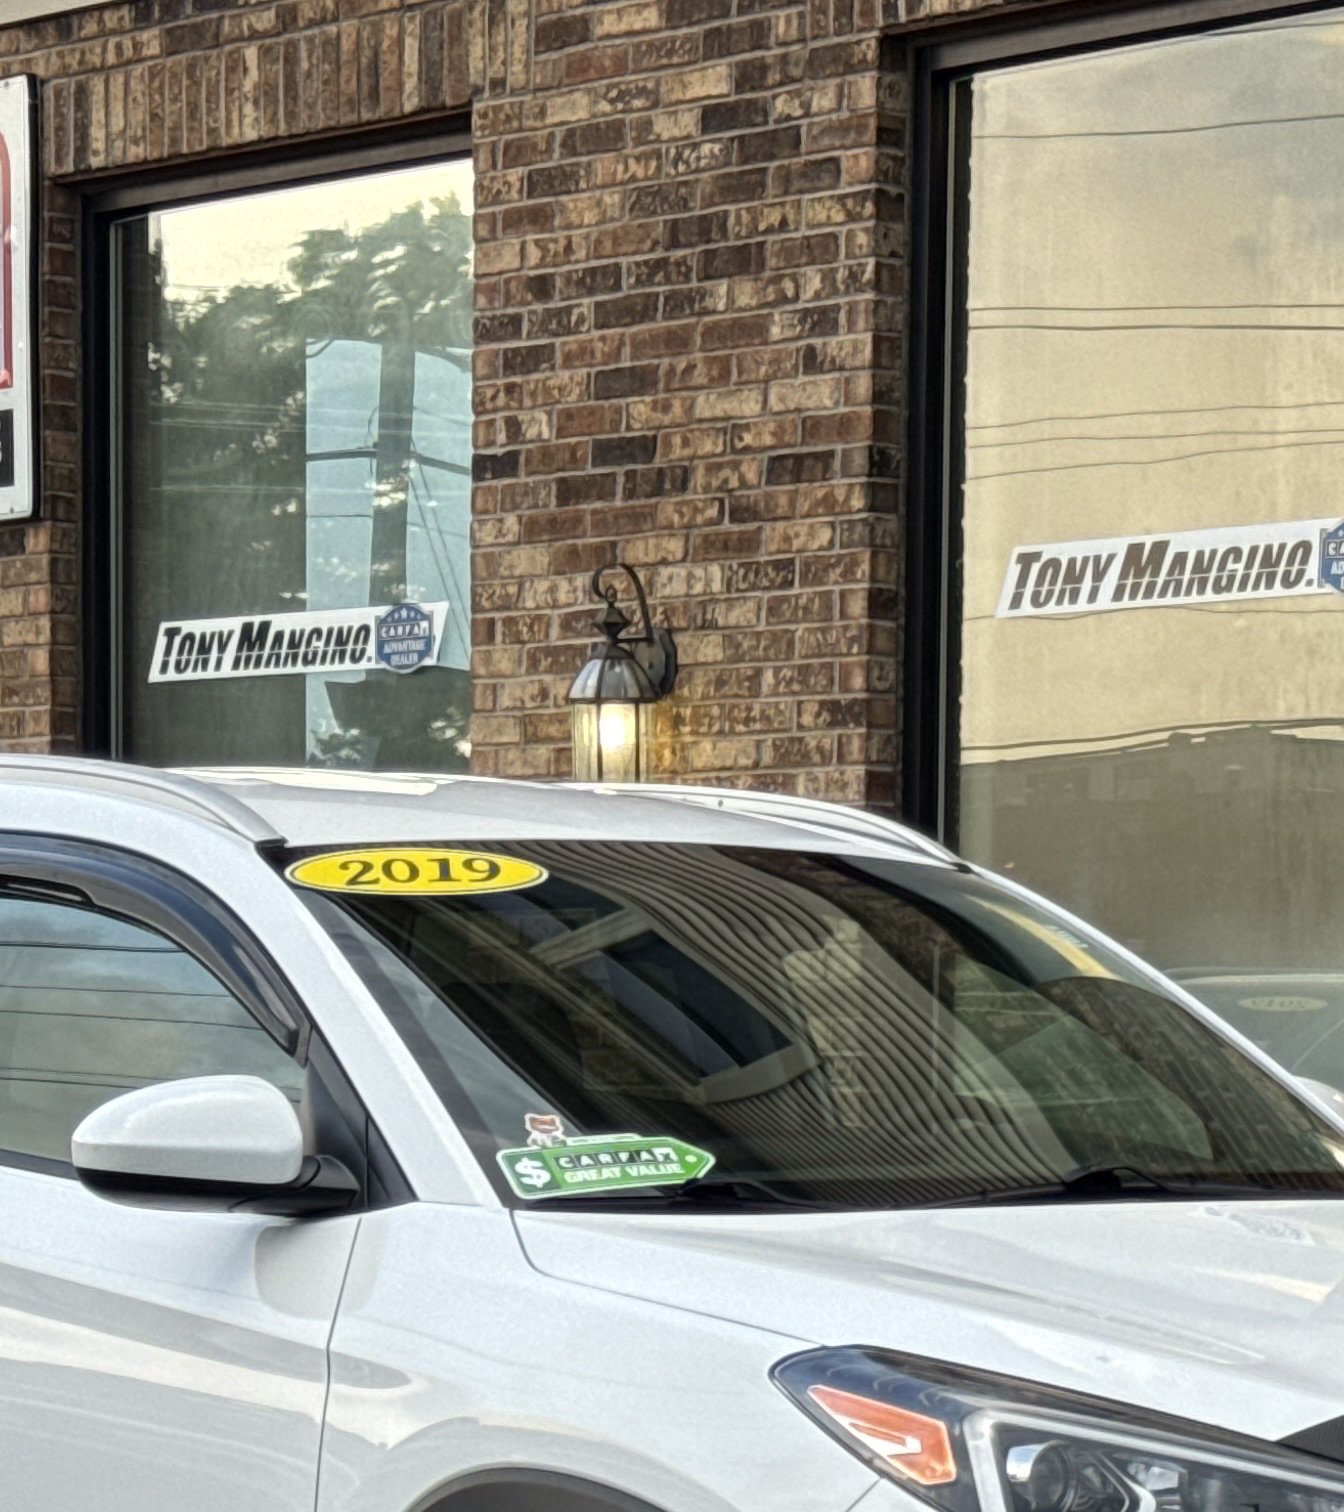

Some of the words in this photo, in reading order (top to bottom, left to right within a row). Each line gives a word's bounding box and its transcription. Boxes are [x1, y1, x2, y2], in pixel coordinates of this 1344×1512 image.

[338, 856, 502, 887] 2019
[555, 1147, 680, 1169] CARFAX
[564, 1164, 622, 1184] GREAT
[624, 1162, 686, 1178] VALUE
